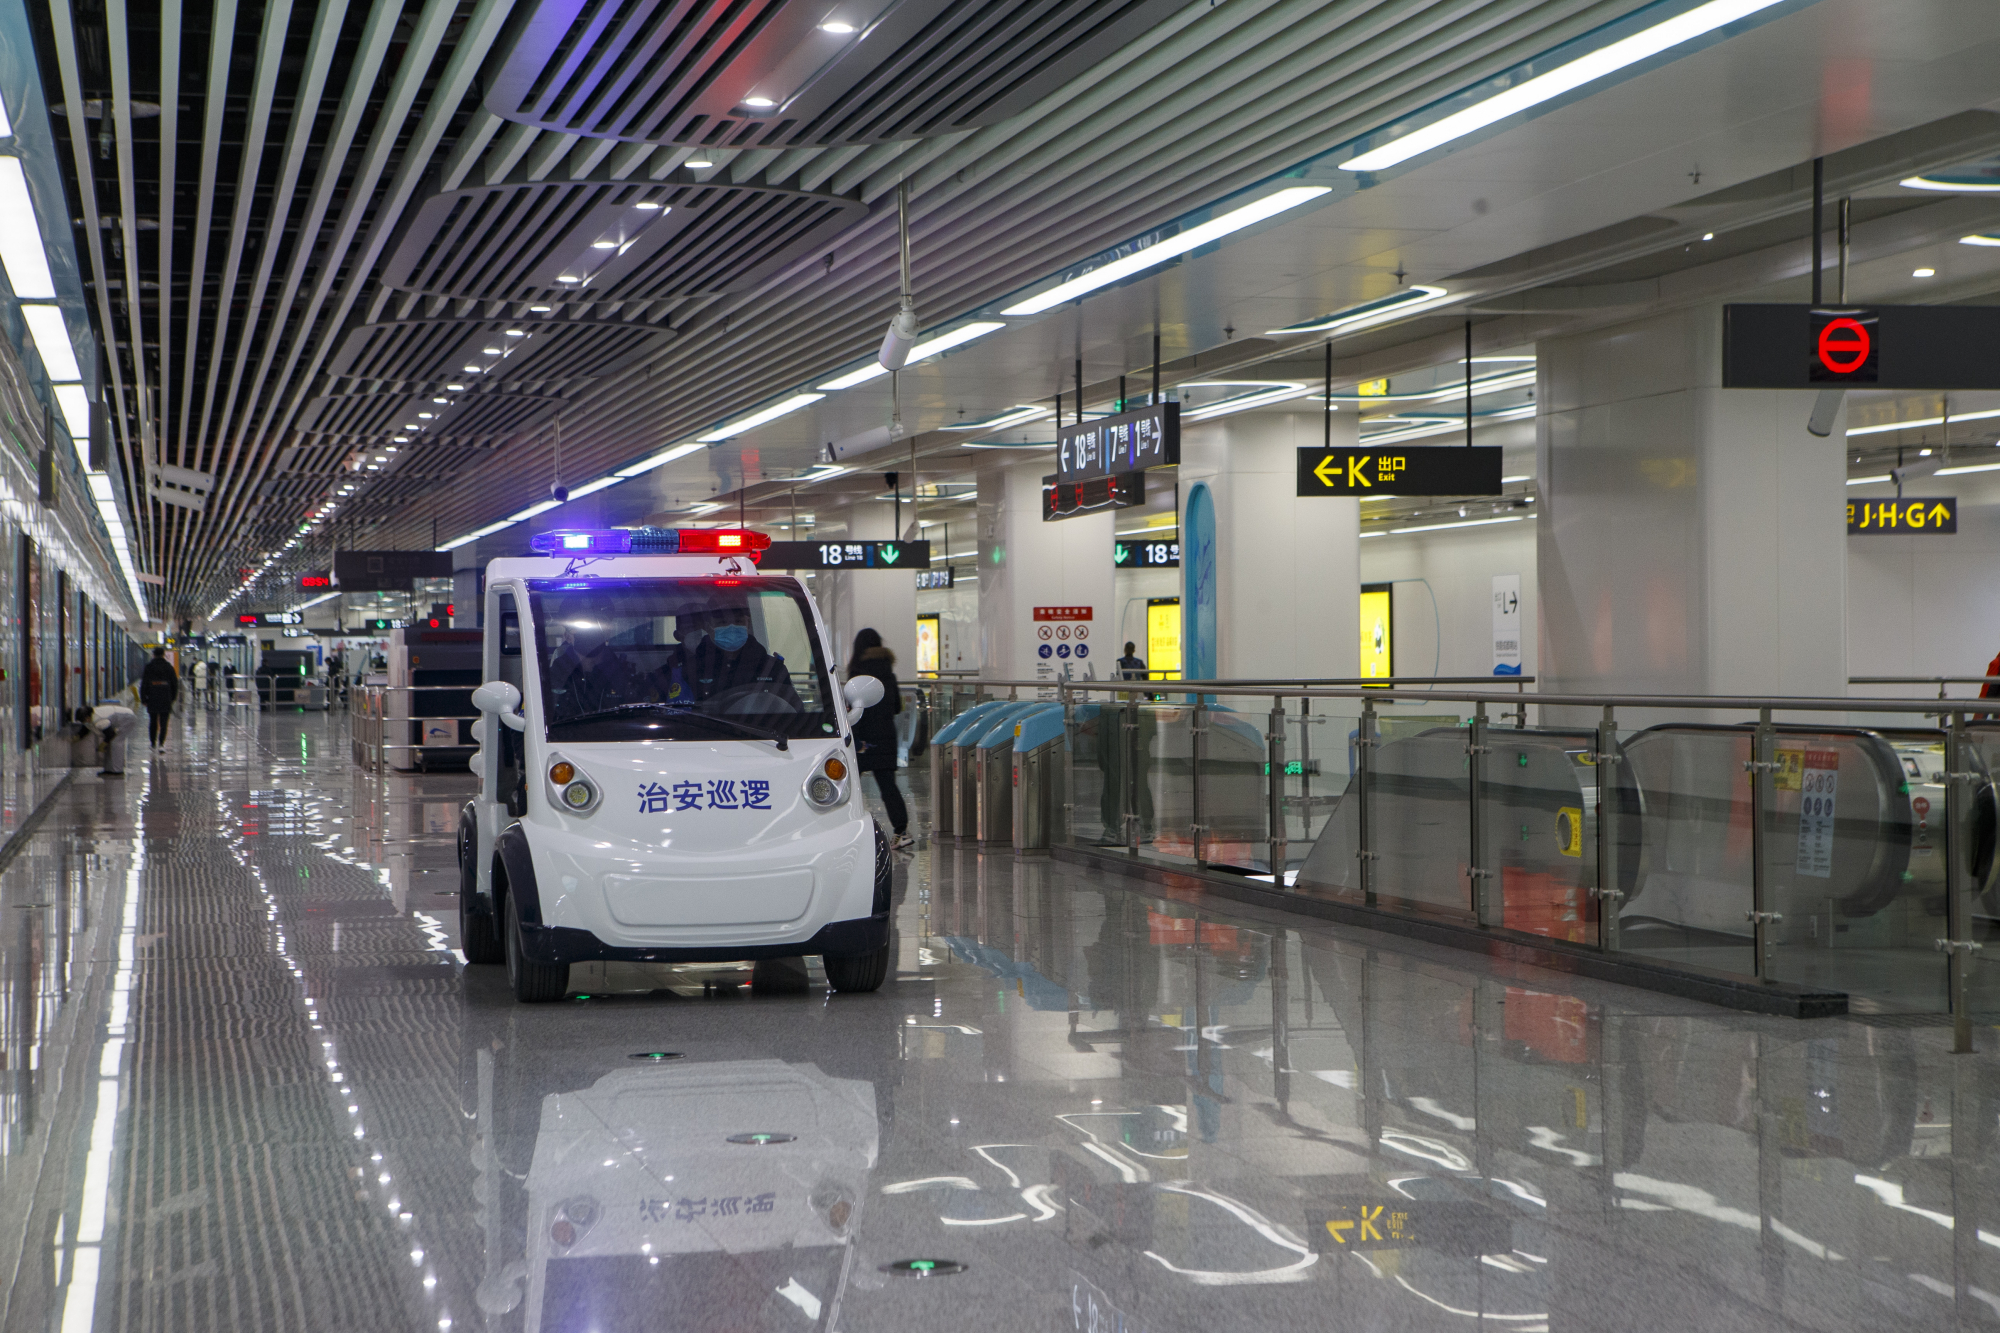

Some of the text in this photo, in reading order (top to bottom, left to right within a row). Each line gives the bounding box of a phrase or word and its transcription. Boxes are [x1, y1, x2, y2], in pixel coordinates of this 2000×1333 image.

[1075, 434, 1086, 470] 18
[1110, 425, 1118, 463] 7
[1135, 420, 1141, 457] 1
[1348, 456, 1372, 487] K
[1378, 455, 1405, 471] 出口
[1378, 472, 1395, 481] Exit
[819, 544, 863, 565] 18 号线
[1145, 543, 1168, 564] 18
[637, 779, 772, 814] 治安巡逻
